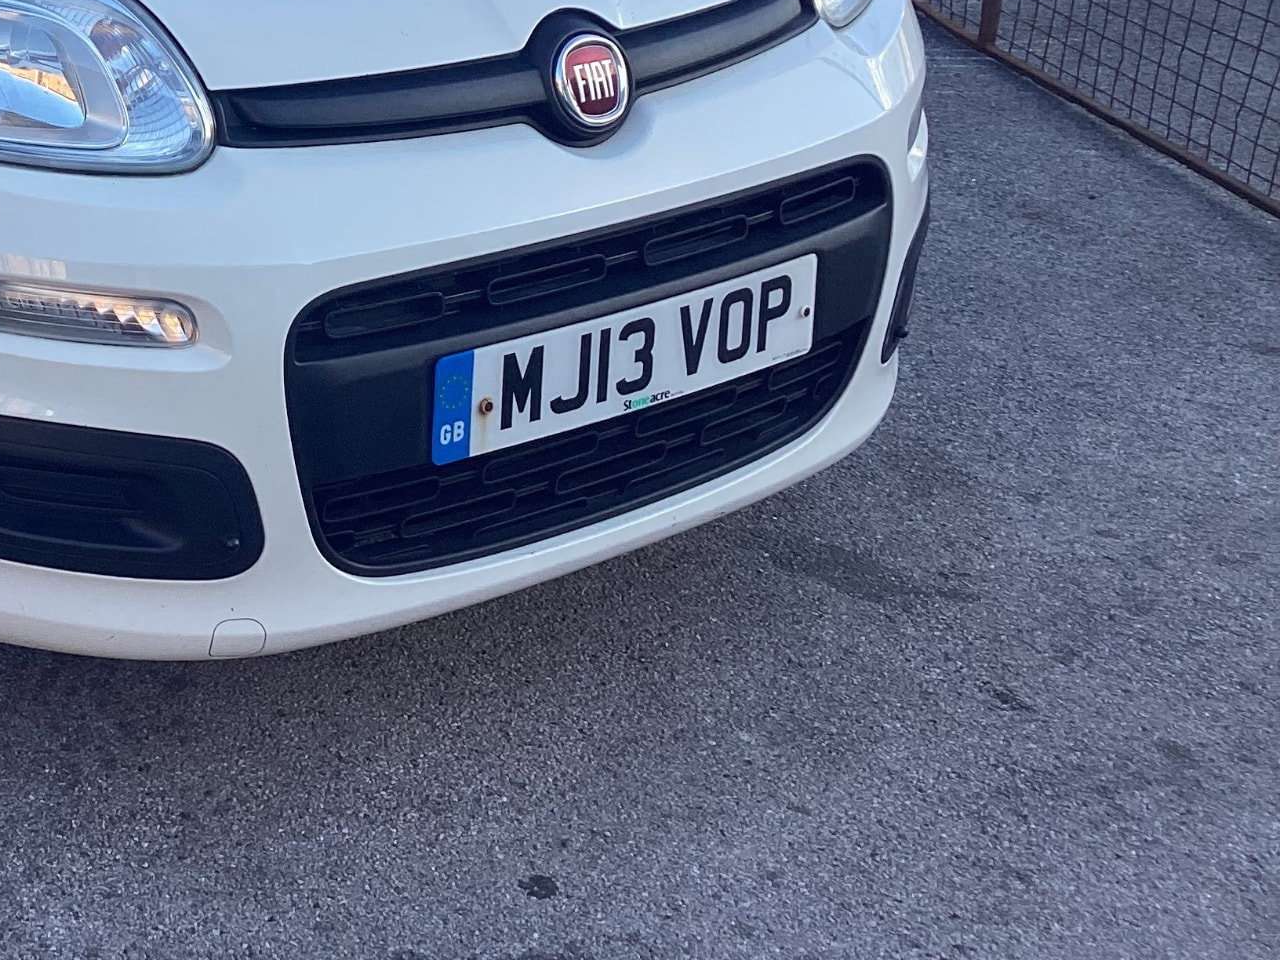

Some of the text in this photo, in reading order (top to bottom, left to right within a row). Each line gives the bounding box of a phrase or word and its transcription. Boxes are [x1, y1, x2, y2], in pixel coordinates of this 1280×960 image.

[573, 59, 615, 103] FIAT
[500, 275, 792, 431] MJ13 VOP
[440, 420, 465, 445] GB
